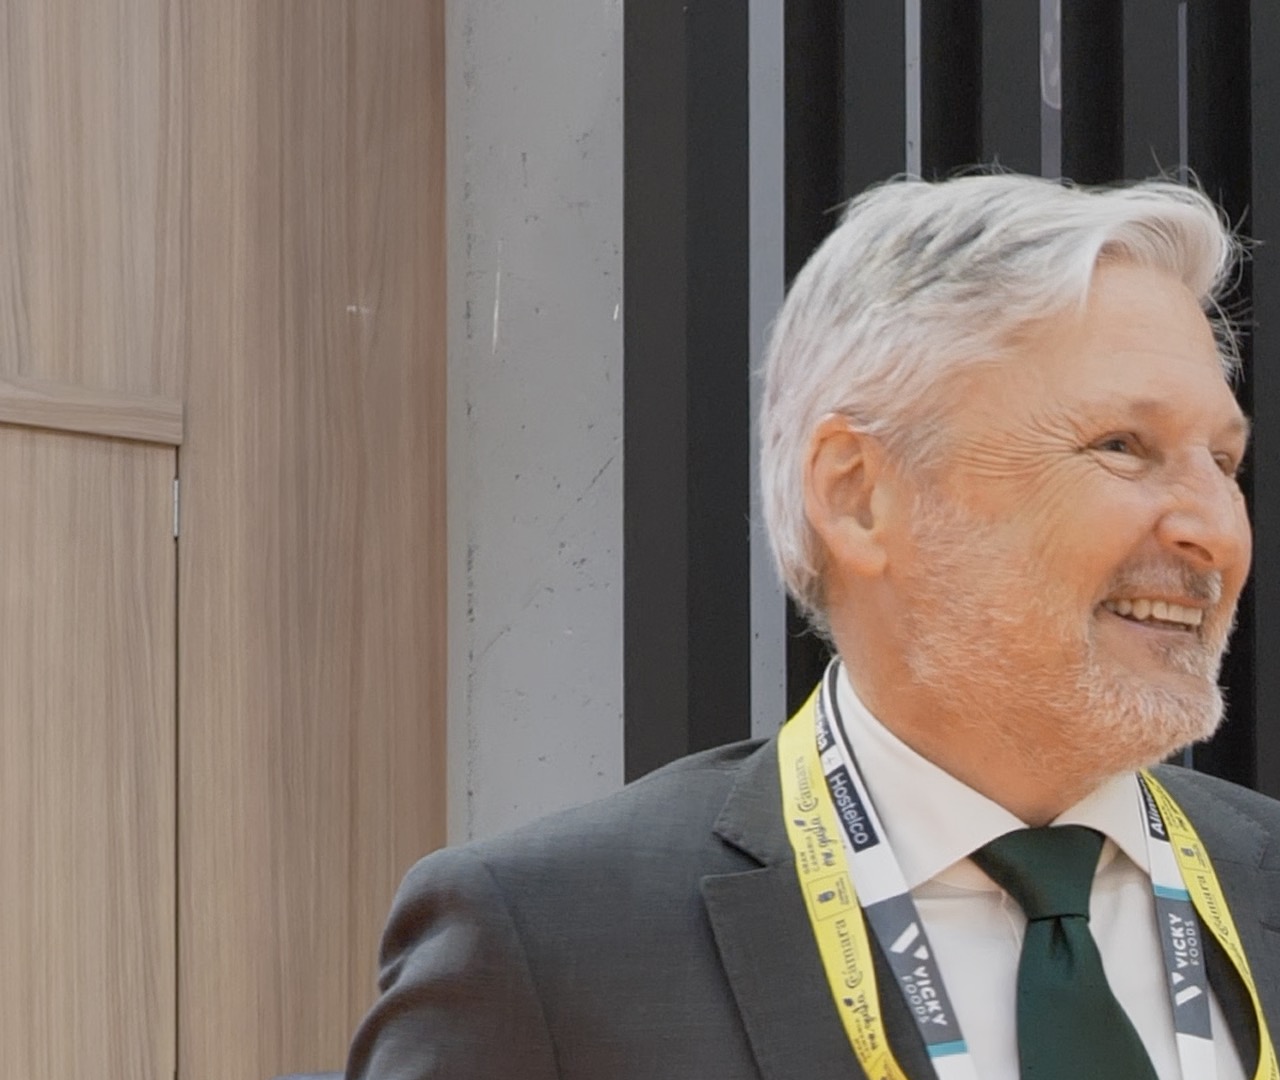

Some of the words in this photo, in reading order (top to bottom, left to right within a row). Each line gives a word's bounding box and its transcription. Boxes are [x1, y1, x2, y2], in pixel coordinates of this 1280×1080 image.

[829, 770, 869, 845] Hostelco
[835, 919, 864, 989] Cámara
[1168, 913, 1188, 969] VICKY
[1185, 920, 1200, 966] FOODS
[901, 975, 931, 1024] FOODS
[914, 966, 949, 1026] VICKY
